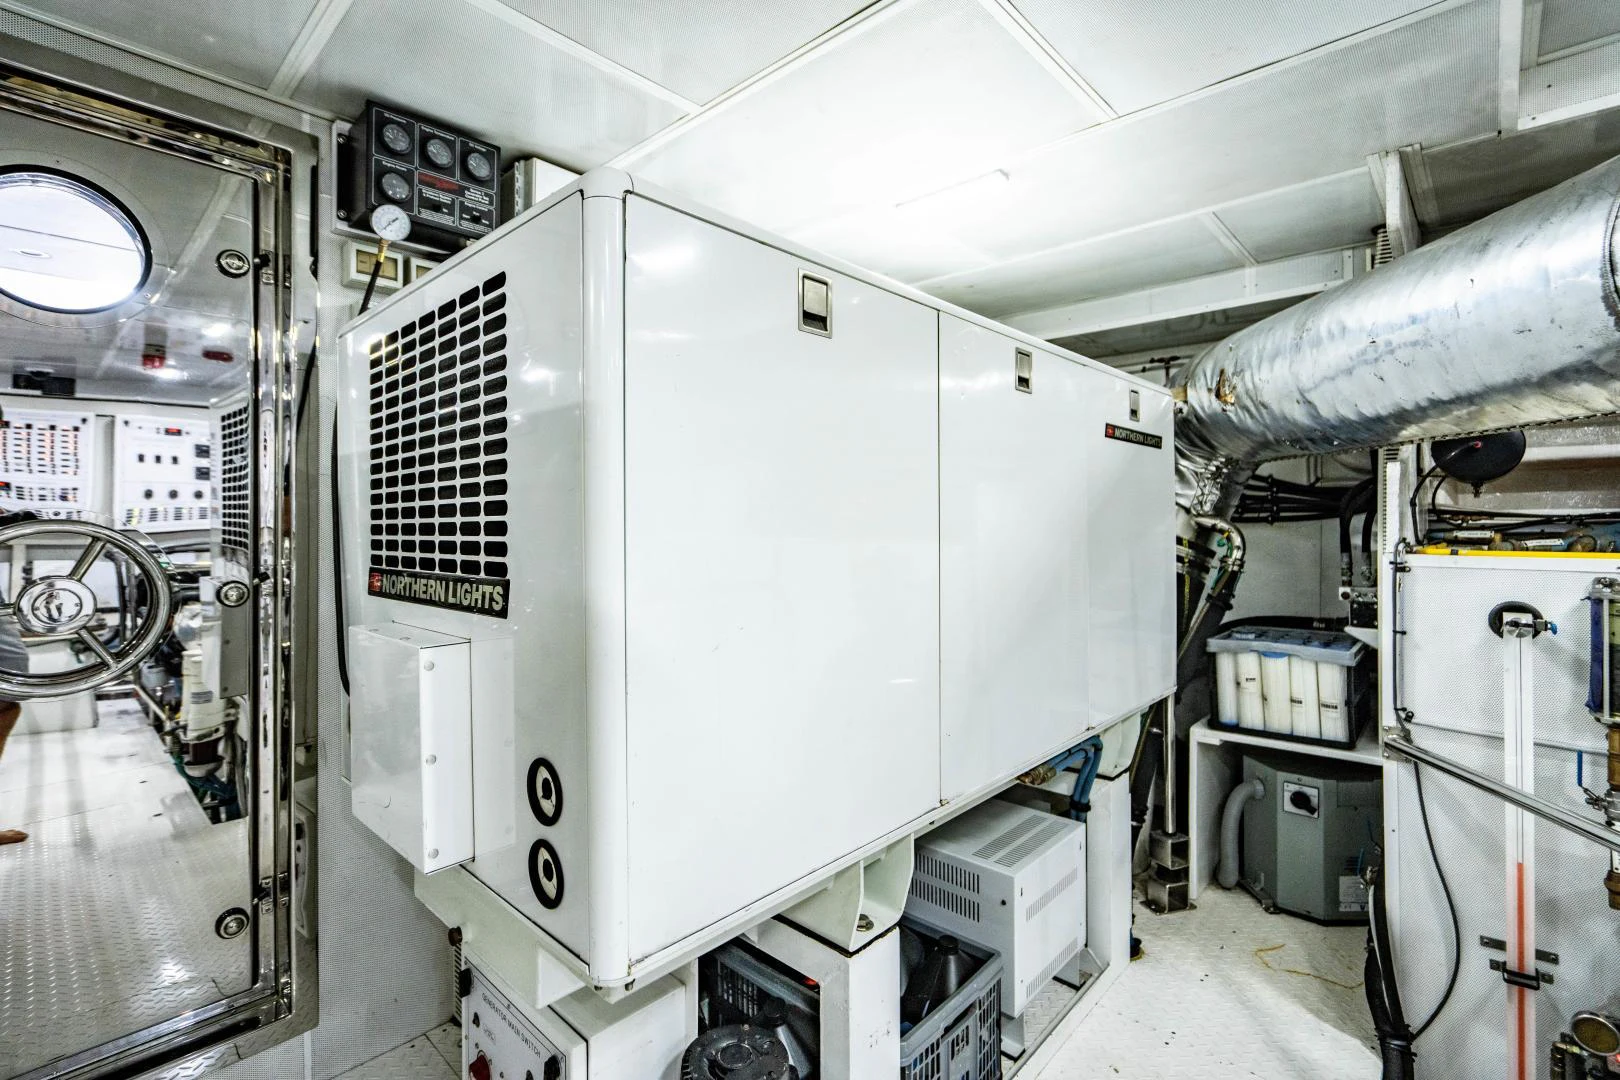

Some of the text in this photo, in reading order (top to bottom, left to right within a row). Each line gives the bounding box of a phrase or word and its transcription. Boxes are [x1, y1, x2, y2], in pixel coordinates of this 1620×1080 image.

[1115, 428, 1161, 447] NORTHERN LIGHTS
[382, 574, 504, 611] NORTHERN LIGHTS
[507, 1020, 521, 1036] MAIN
[520, 1033, 541, 1058] SWITCH
